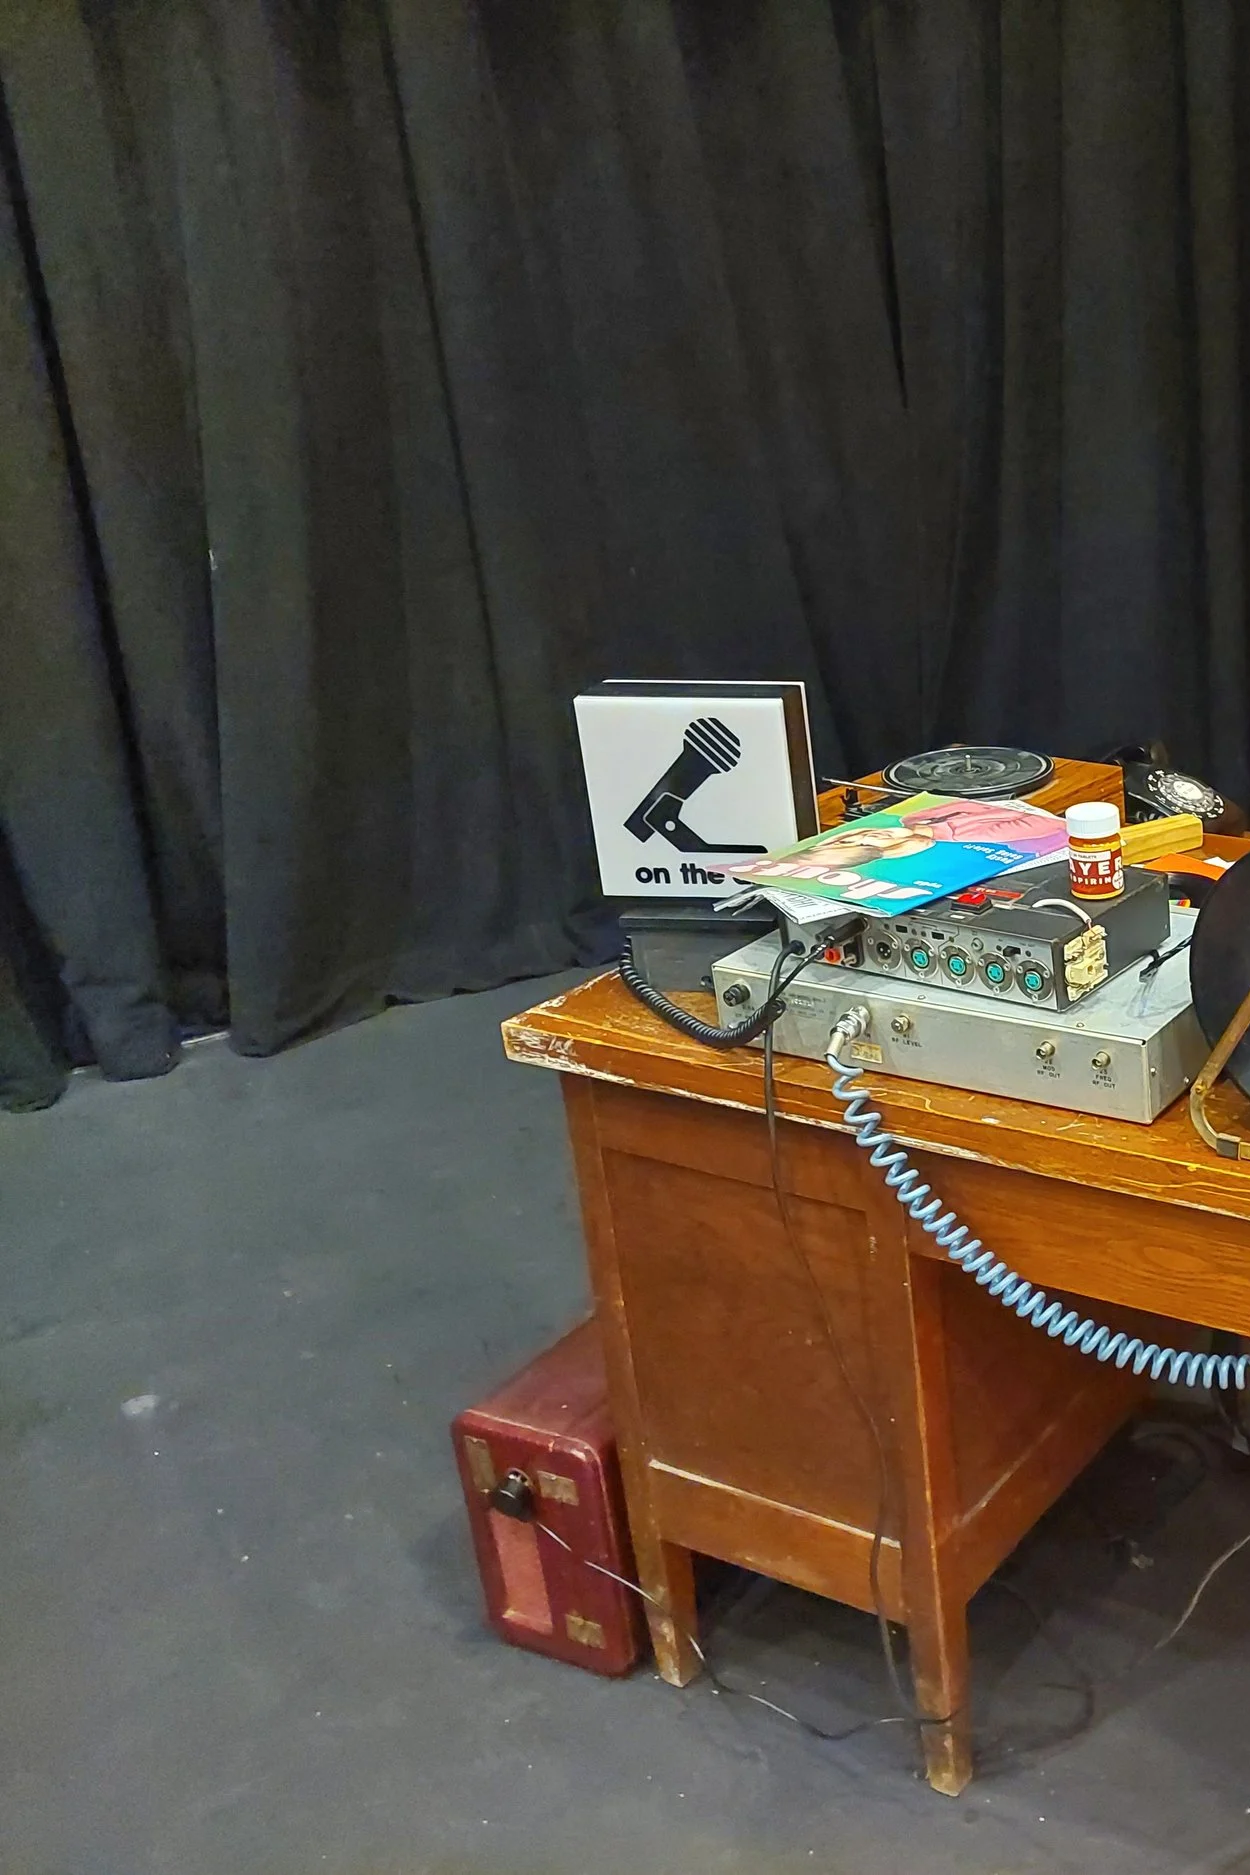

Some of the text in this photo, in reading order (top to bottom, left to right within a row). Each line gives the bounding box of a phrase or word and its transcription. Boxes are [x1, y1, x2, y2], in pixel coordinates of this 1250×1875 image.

[635, 866, 672, 884] on
[679, 862, 726, 885] the
[1070, 873, 1112, 885] SPIRIN
[902, 1039, 922, 1048] LEVEL
